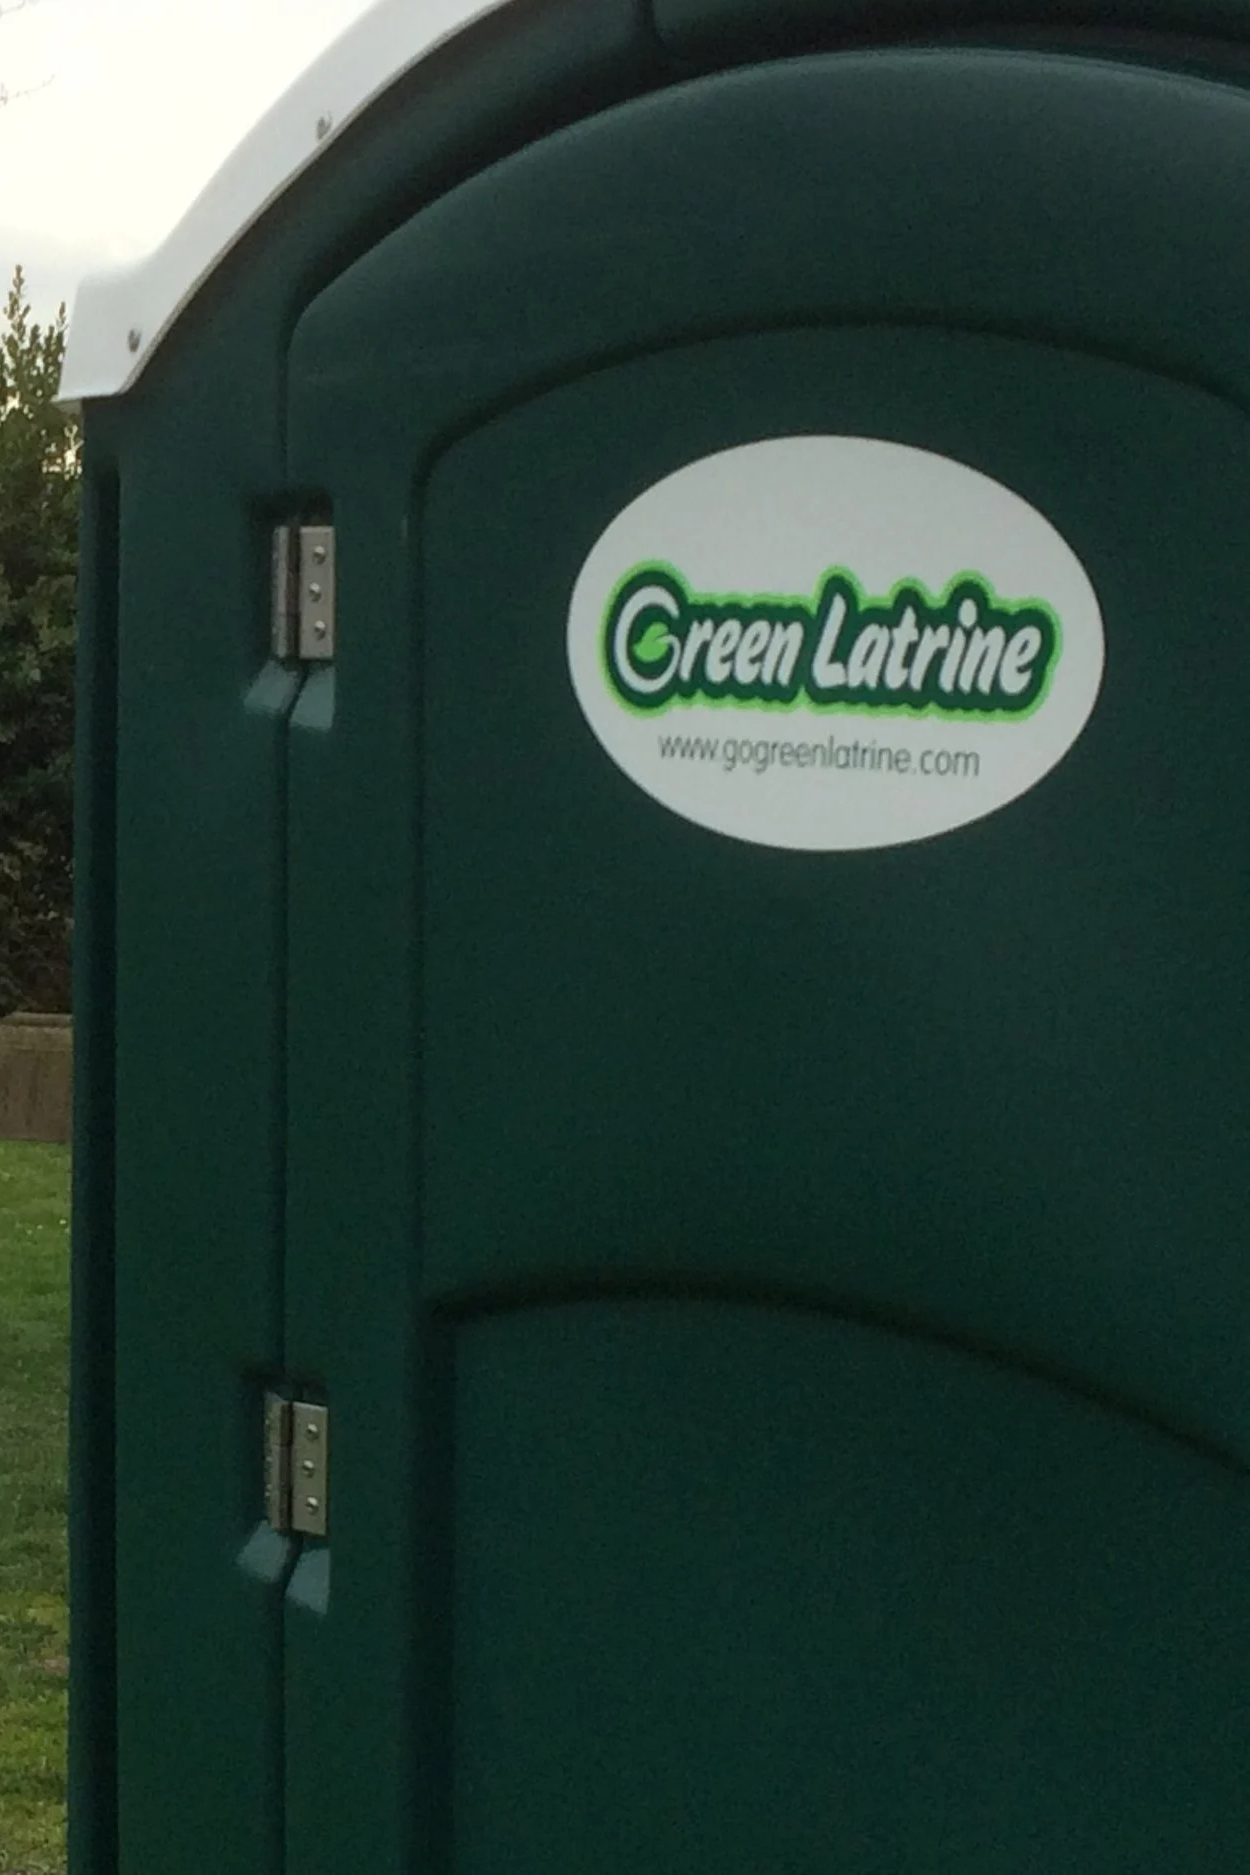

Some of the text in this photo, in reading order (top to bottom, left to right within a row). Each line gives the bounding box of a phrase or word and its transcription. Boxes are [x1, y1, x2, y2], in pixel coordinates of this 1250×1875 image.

[613, 584, 1042, 695] Green Latrine
[658, 734, 981, 777] www.gogreenlatrine.com
